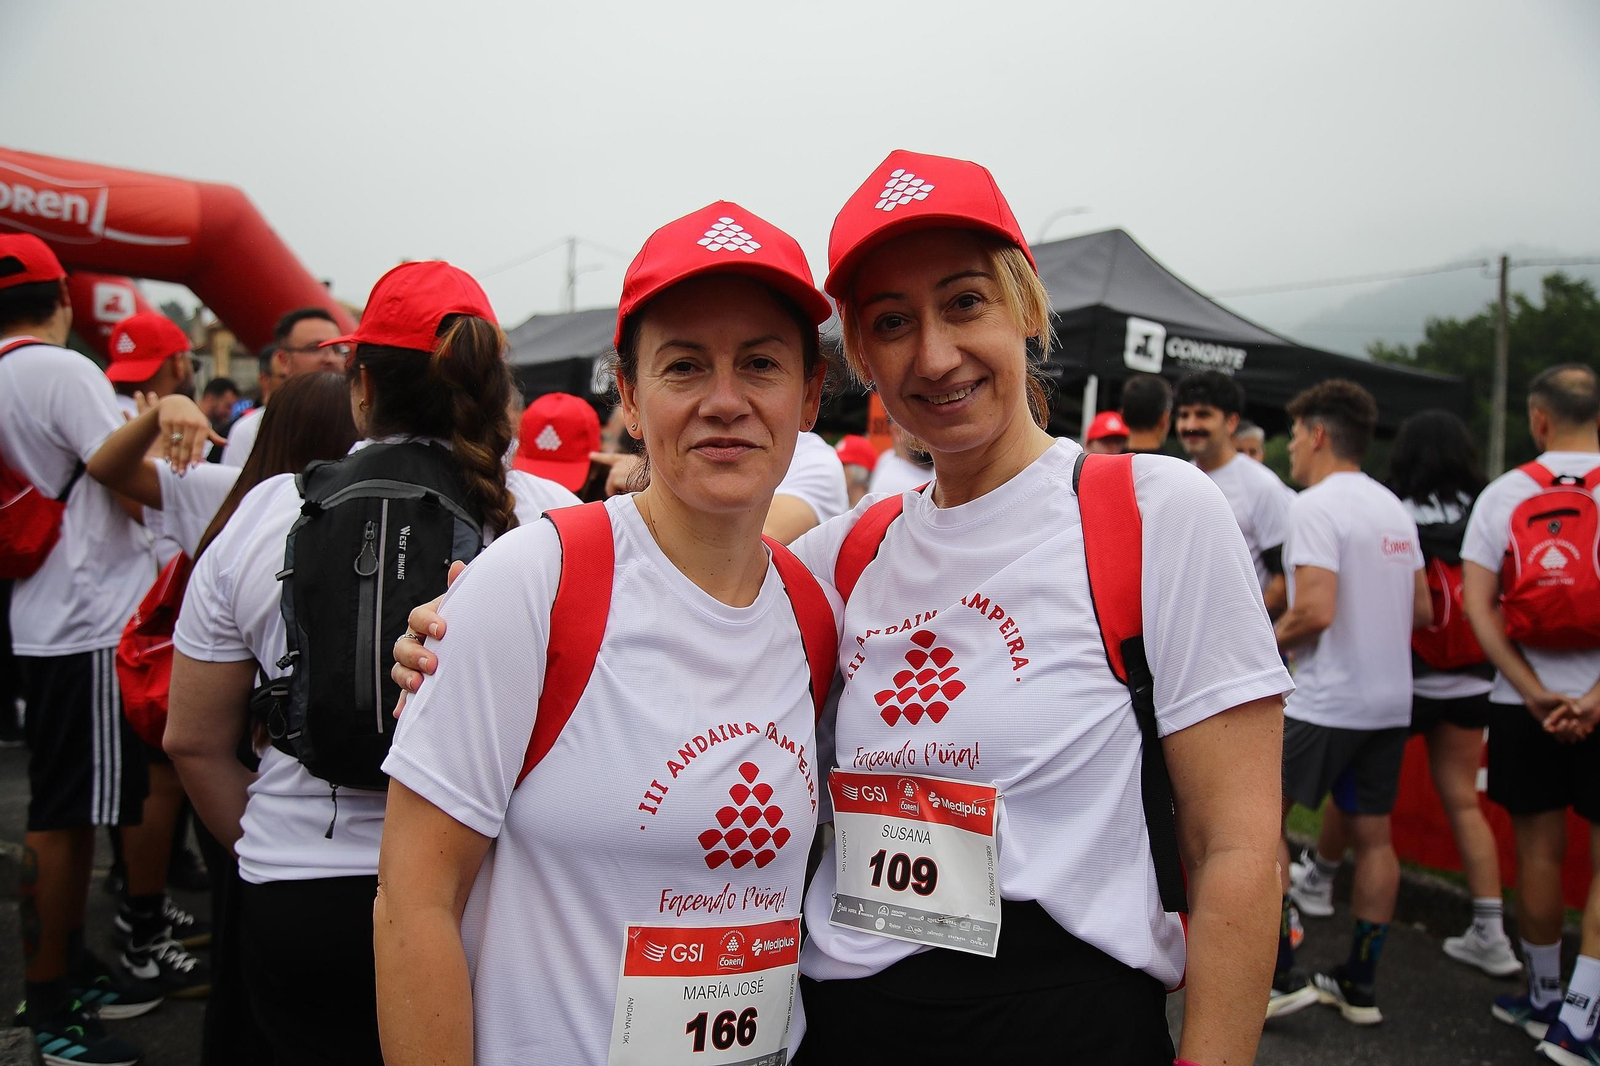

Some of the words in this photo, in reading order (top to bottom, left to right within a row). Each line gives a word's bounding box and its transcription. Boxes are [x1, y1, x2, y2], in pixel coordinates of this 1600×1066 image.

[399, 525, 411, 551] WEST
[397, 553, 406, 580] BIKING
[855, 609, 938, 651] ANDAIN
[960, 592, 1029, 671] MPEIRA
[666, 722, 760, 778] ANDAINA
[853, 740, 916, 771] Facendo
[924, 742, 980, 771] Piña!
[861, 785, 888, 803] GSI
[941, 797, 987, 818] Mediplus
[881, 824, 932, 845] SUSANA
[868, 849, 938, 897] 109
[659, 882, 737, 917] Facendo
[742, 885, 788, 914] Piña!
[670, 943, 704, 963] GSI
[763, 936, 795, 953] Mediplus
[683, 981, 730, 1000] MARÍA
[733, 976, 765, 997] JOSÉ
[625, 997, 635, 1030] ANDAINA
[622, 1031, 630, 1045] 10K
[685, 1006, 758, 1053] 166
